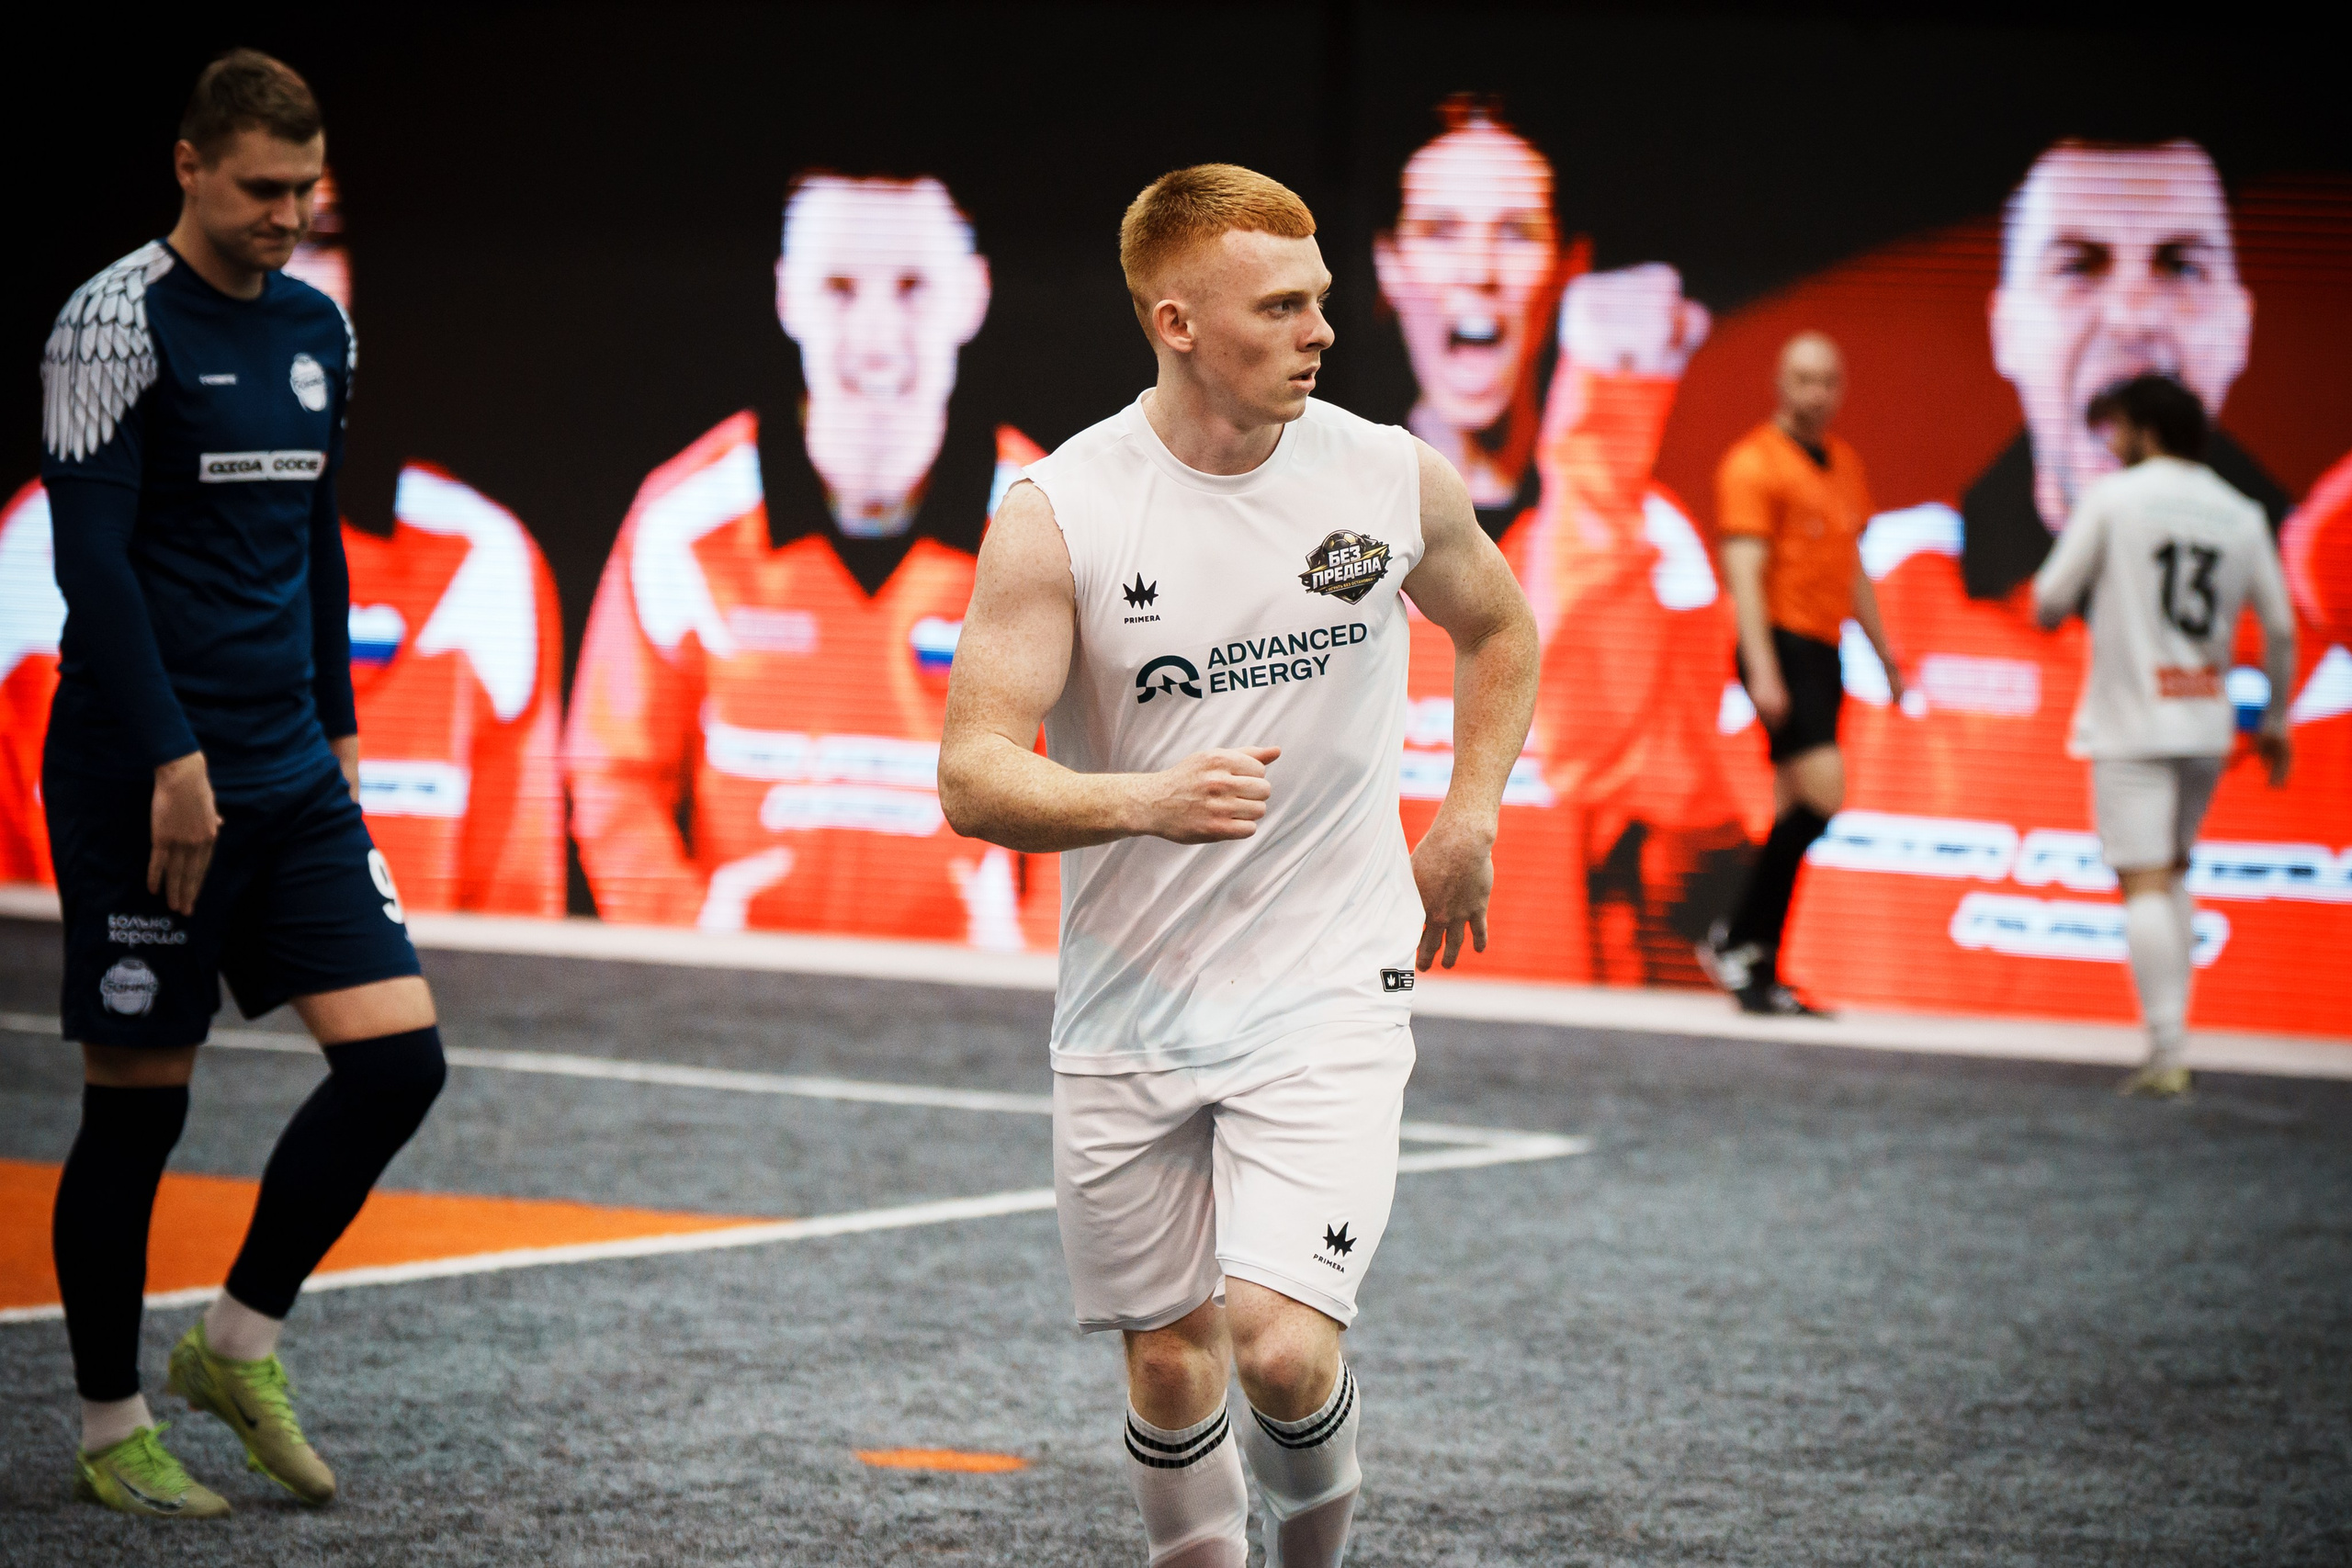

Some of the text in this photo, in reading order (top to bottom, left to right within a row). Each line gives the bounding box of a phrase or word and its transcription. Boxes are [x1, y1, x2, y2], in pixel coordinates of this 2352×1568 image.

[273, 458, 318, 471] CODE
[1311, 556, 1382, 590] ПРЕДЕЛА
[1328, 545, 1362, 568] БЕЗ
[2154, 540, 2220, 640] 13
[1124, 614, 1161, 625] PRIMERA
[1207, 623, 1368, 670] ADVANCED
[1209, 653, 1331, 694] ENERGY
[368, 848, 405, 924] 9
[1312, 1253, 1346, 1274] PRIMERA
